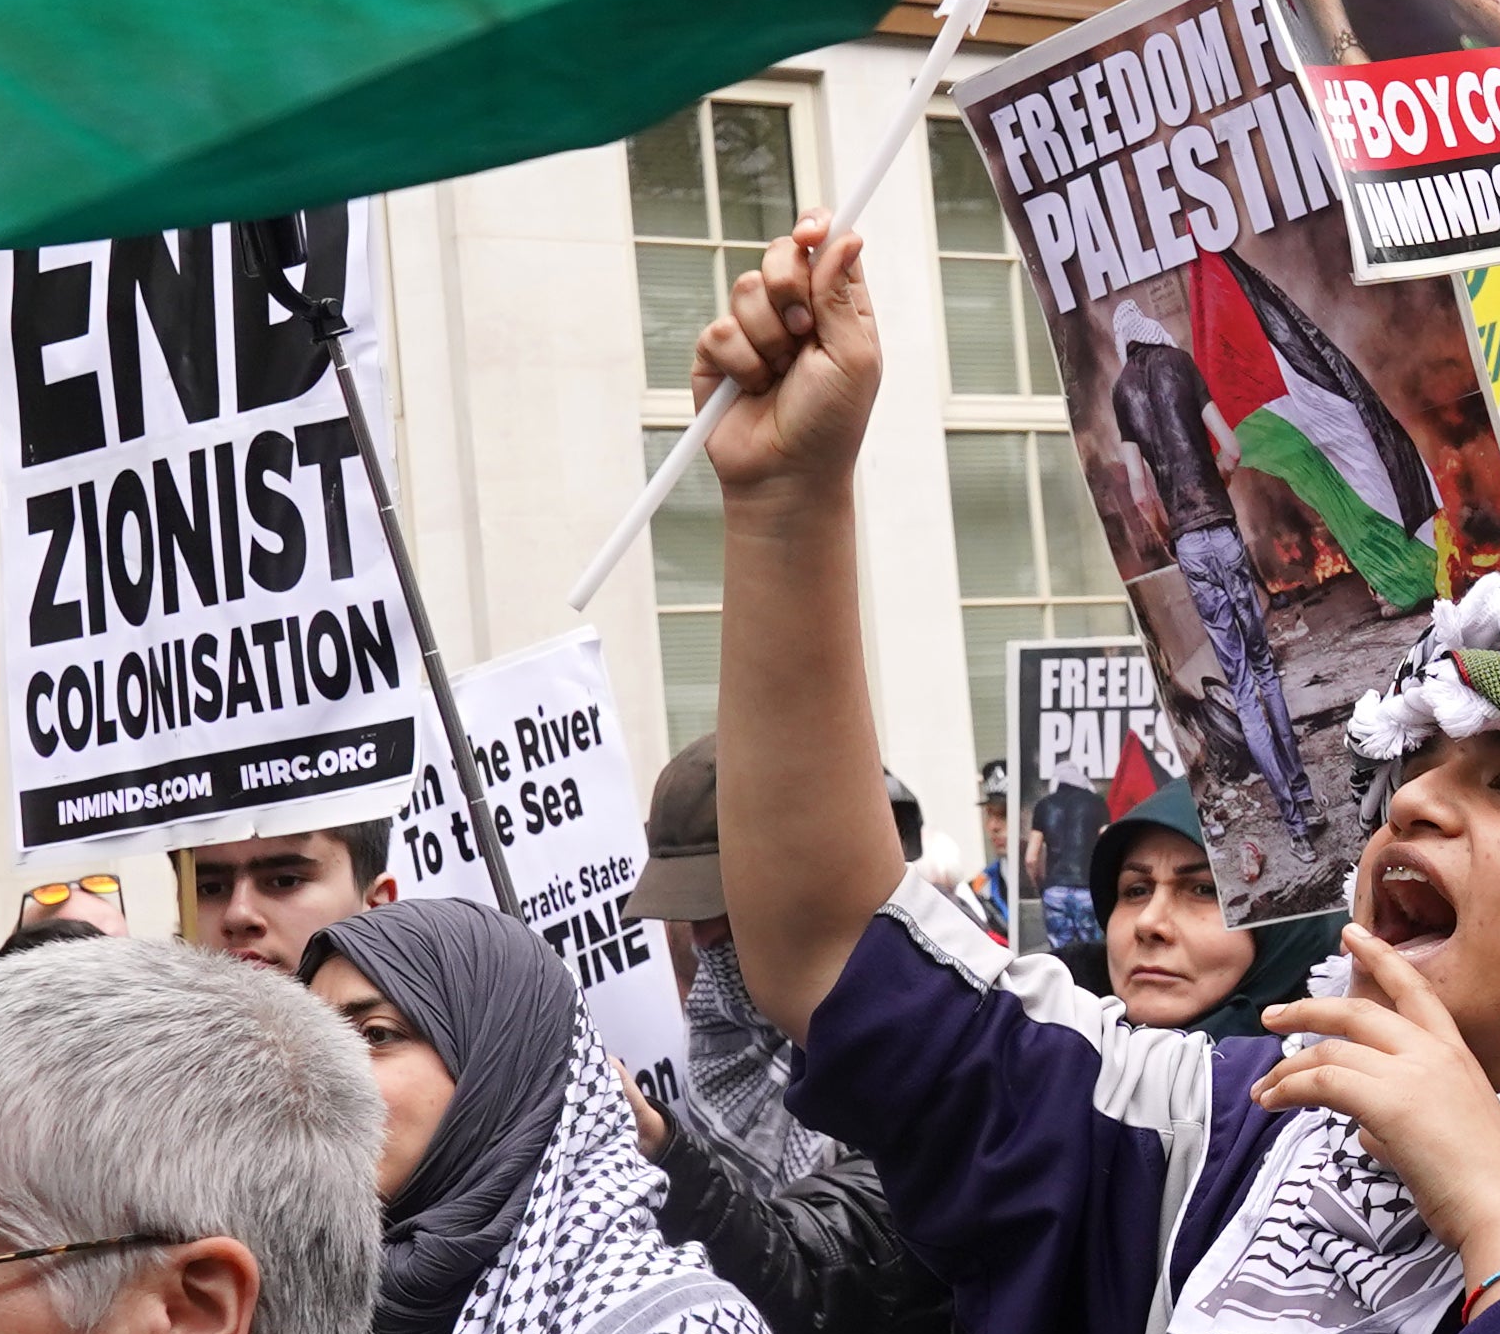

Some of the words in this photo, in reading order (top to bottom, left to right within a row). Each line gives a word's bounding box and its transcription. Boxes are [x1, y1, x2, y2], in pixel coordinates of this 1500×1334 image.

[990, 6, 1242, 195] FREEDOM
[11, 197, 350, 468] END
[26, 416, 362, 648] ZIONIST
[26, 599, 400, 758] COLONISATION
[516, 704, 602, 772] River
[57, 771, 213, 827] INMINDS.COM
[239, 742, 378, 792] IHRC.ORG
[403, 823, 443, 882] To
[451, 804, 515, 863] te
[520, 778, 583, 837] Sea
[581, 855, 636, 898] State:
